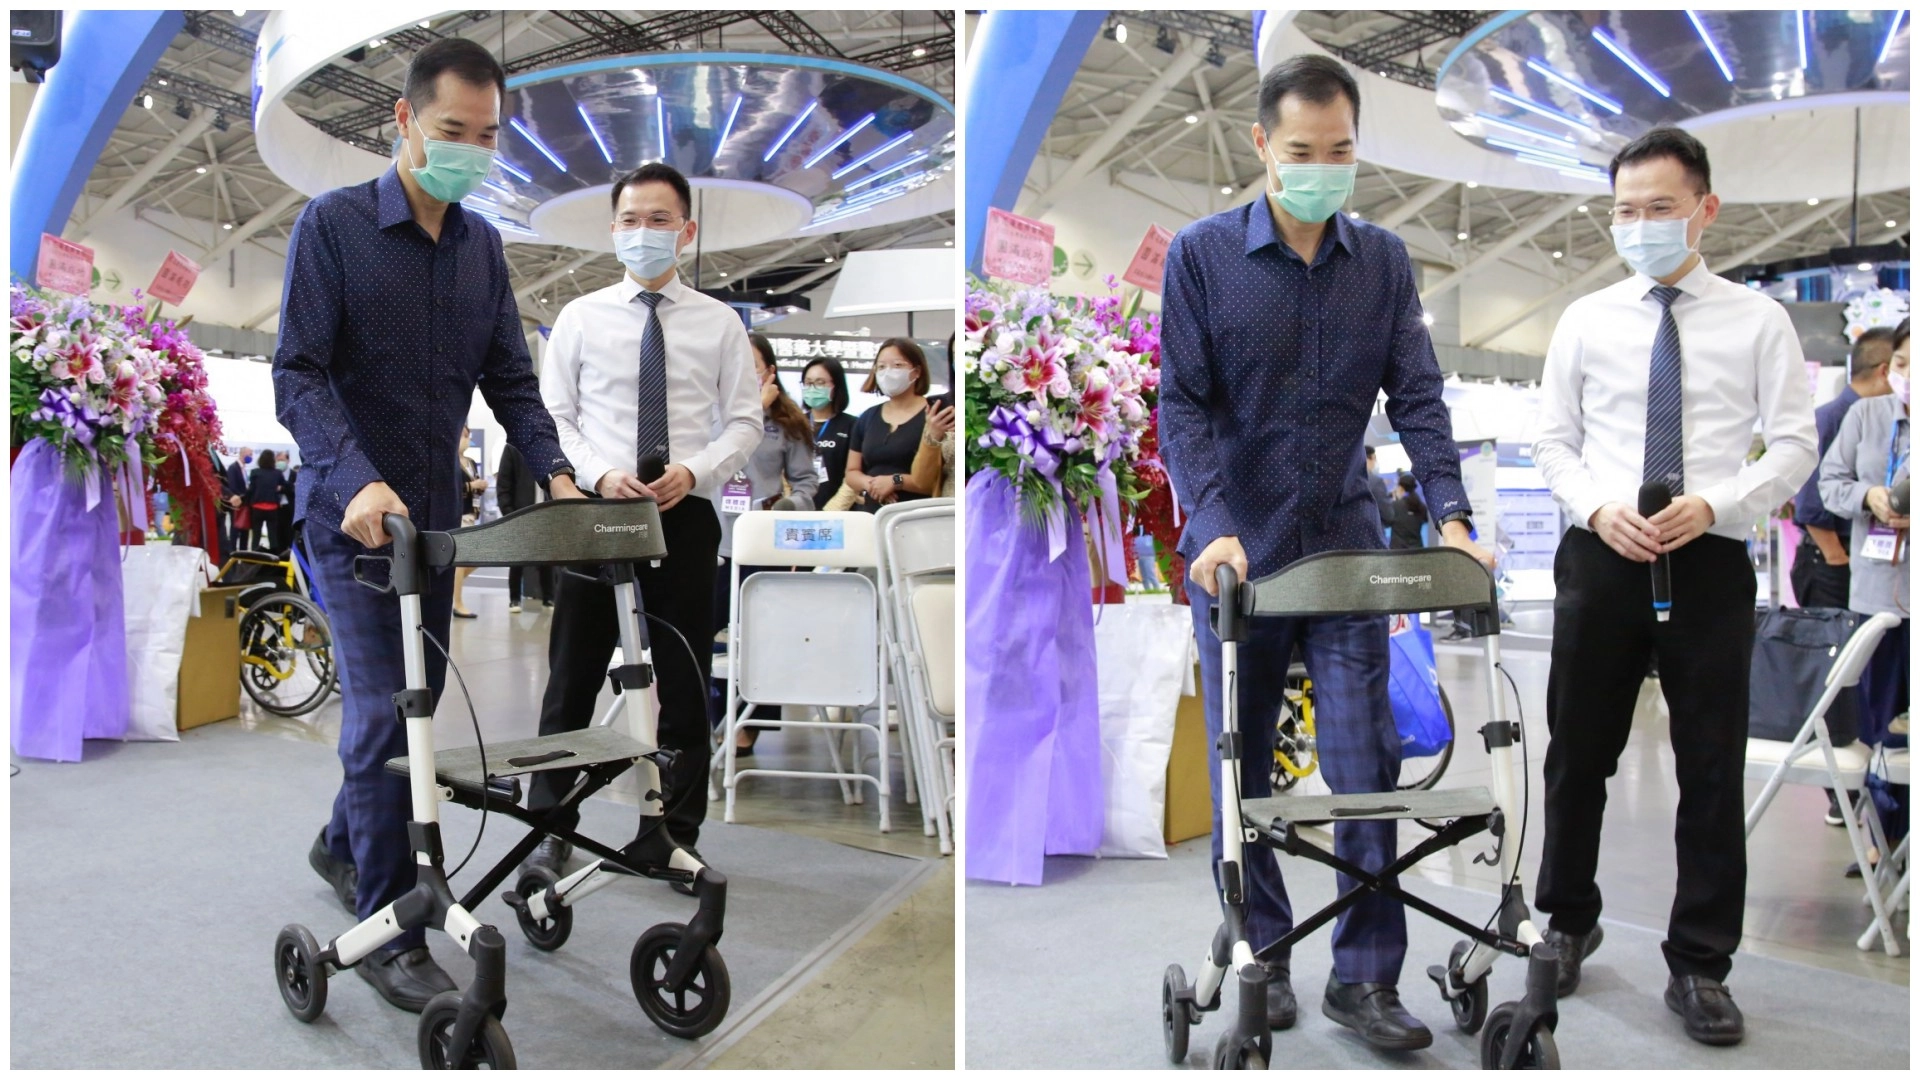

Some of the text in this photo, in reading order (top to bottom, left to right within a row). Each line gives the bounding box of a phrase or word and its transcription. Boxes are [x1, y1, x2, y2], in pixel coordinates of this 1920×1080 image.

[594, 523, 648, 533] Charmingcare
[784, 528, 832, 541] 貴賓席
[1369, 574, 1432, 585] Charmingcare
